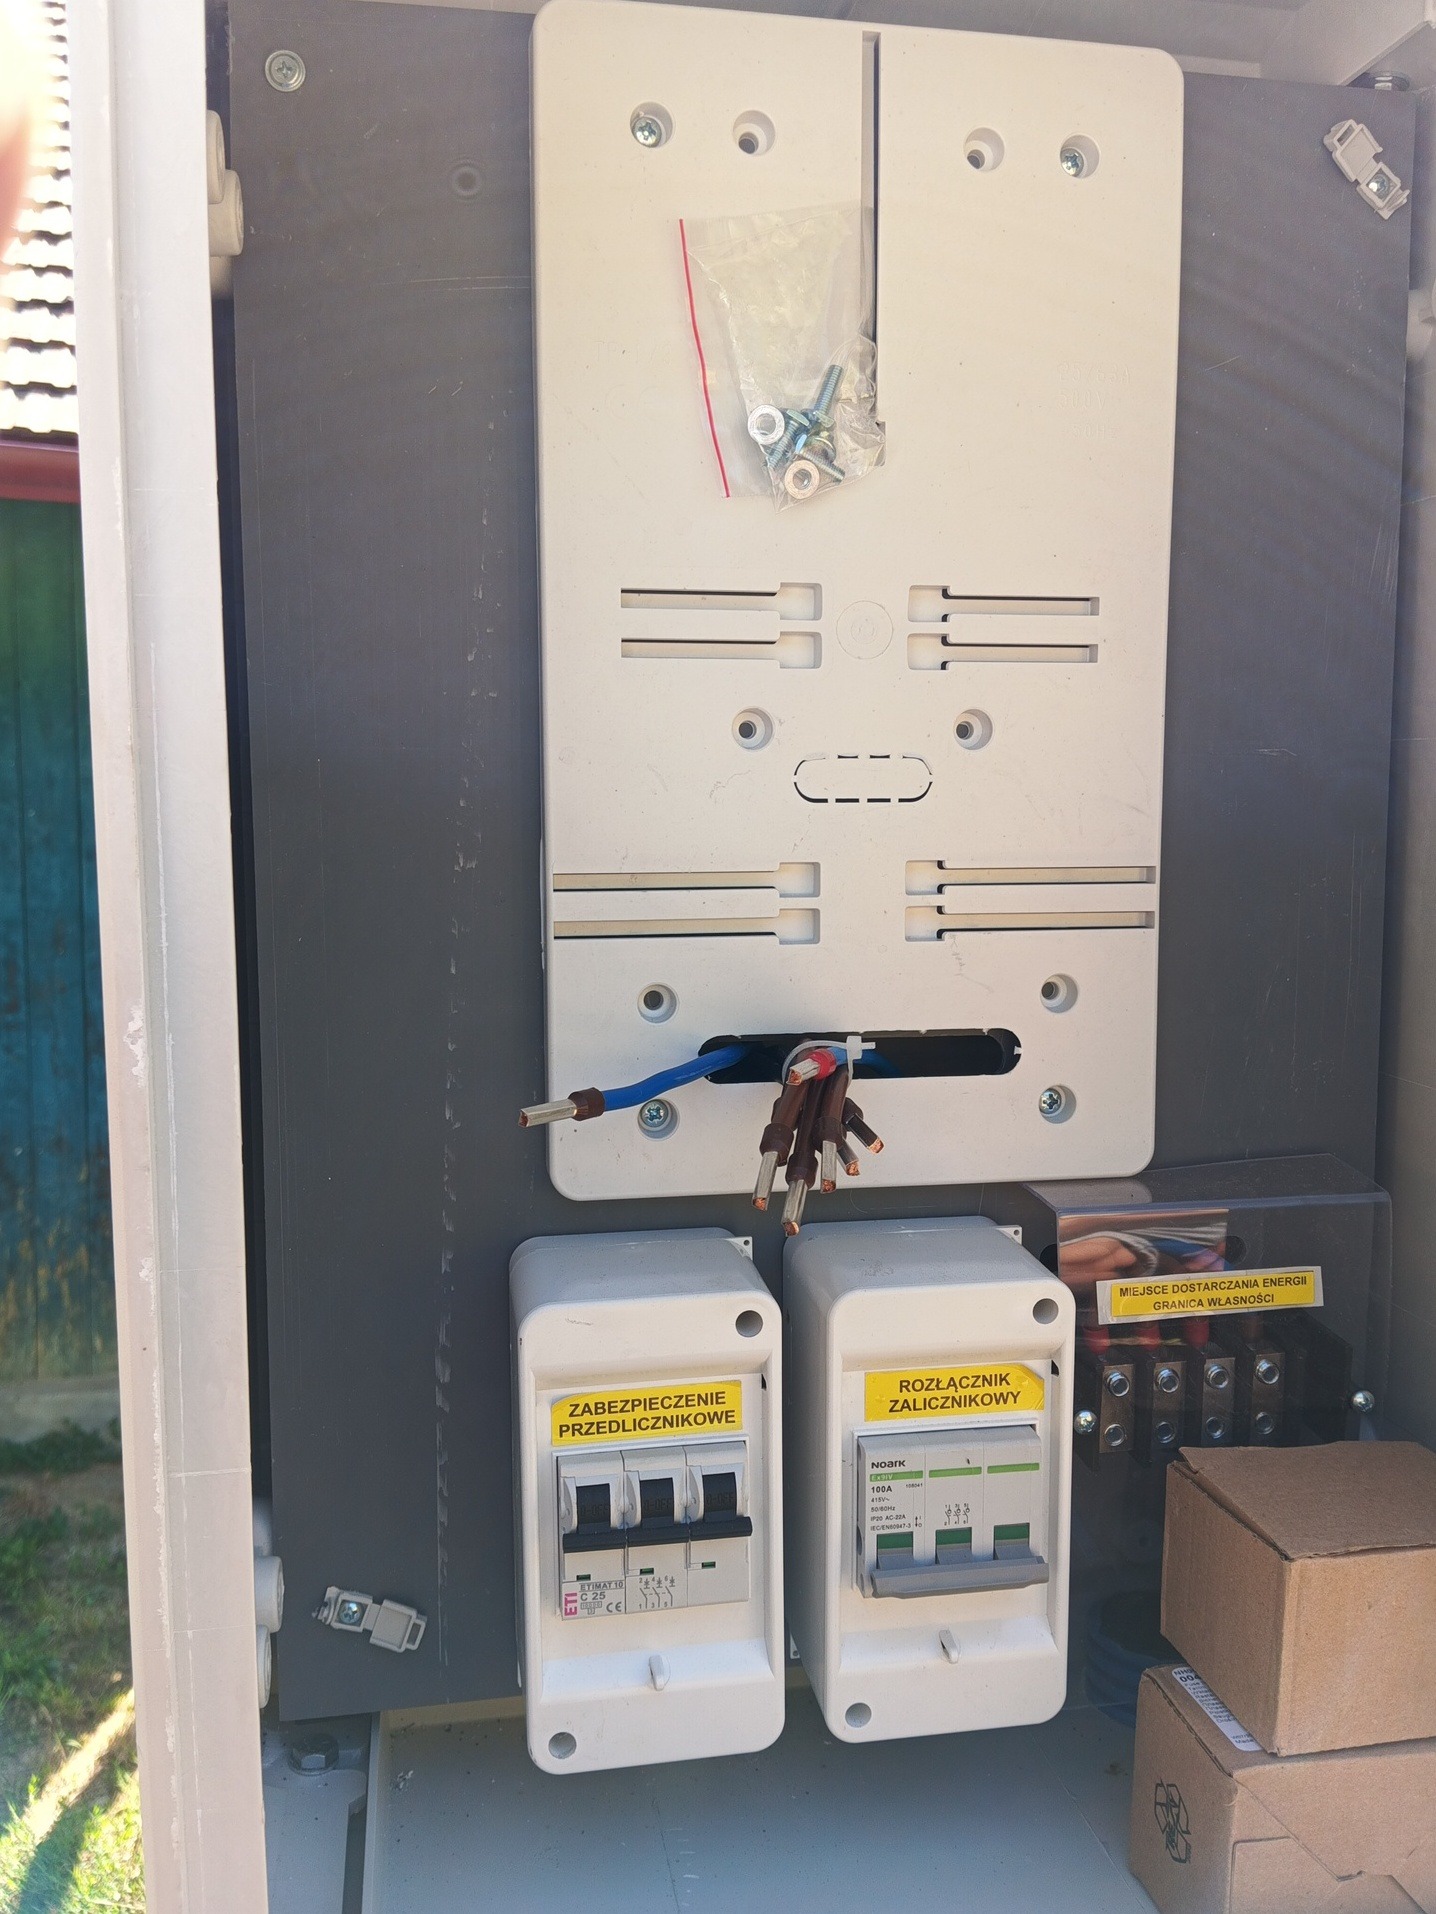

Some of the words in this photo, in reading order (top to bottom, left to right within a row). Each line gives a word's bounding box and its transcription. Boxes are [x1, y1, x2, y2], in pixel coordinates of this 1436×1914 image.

[1119, 1282, 1168, 1297] MIEJSCE
[1172, 1279, 1259, 1294] DOSTARCZANIA
[1263, 1276, 1307, 1289] ENERGII
[1153, 1297, 1204, 1311] GRANICA
[1207, 1291, 1275, 1307] WŁASNOŚCI
[899, 1372, 1011, 1394] ROZŁĄCZNIK
[568, 1391, 726, 1418] ZABEZPIECZENIE
[888, 1391, 1021, 1413] ZALICZNIKOWY
[558, 1410, 736, 1438] PRZEDLICZNIKOWE
[871, 1485, 893, 1494] 100A
[871, 1523, 912, 1532] IEC/EN60947-3
[580, 1582, 612, 1591] ETIMAT
[580, 1593, 588, 1601] C
[592, 1591, 606, 1600] 25
[564, 1592, 578, 1616] ETI
